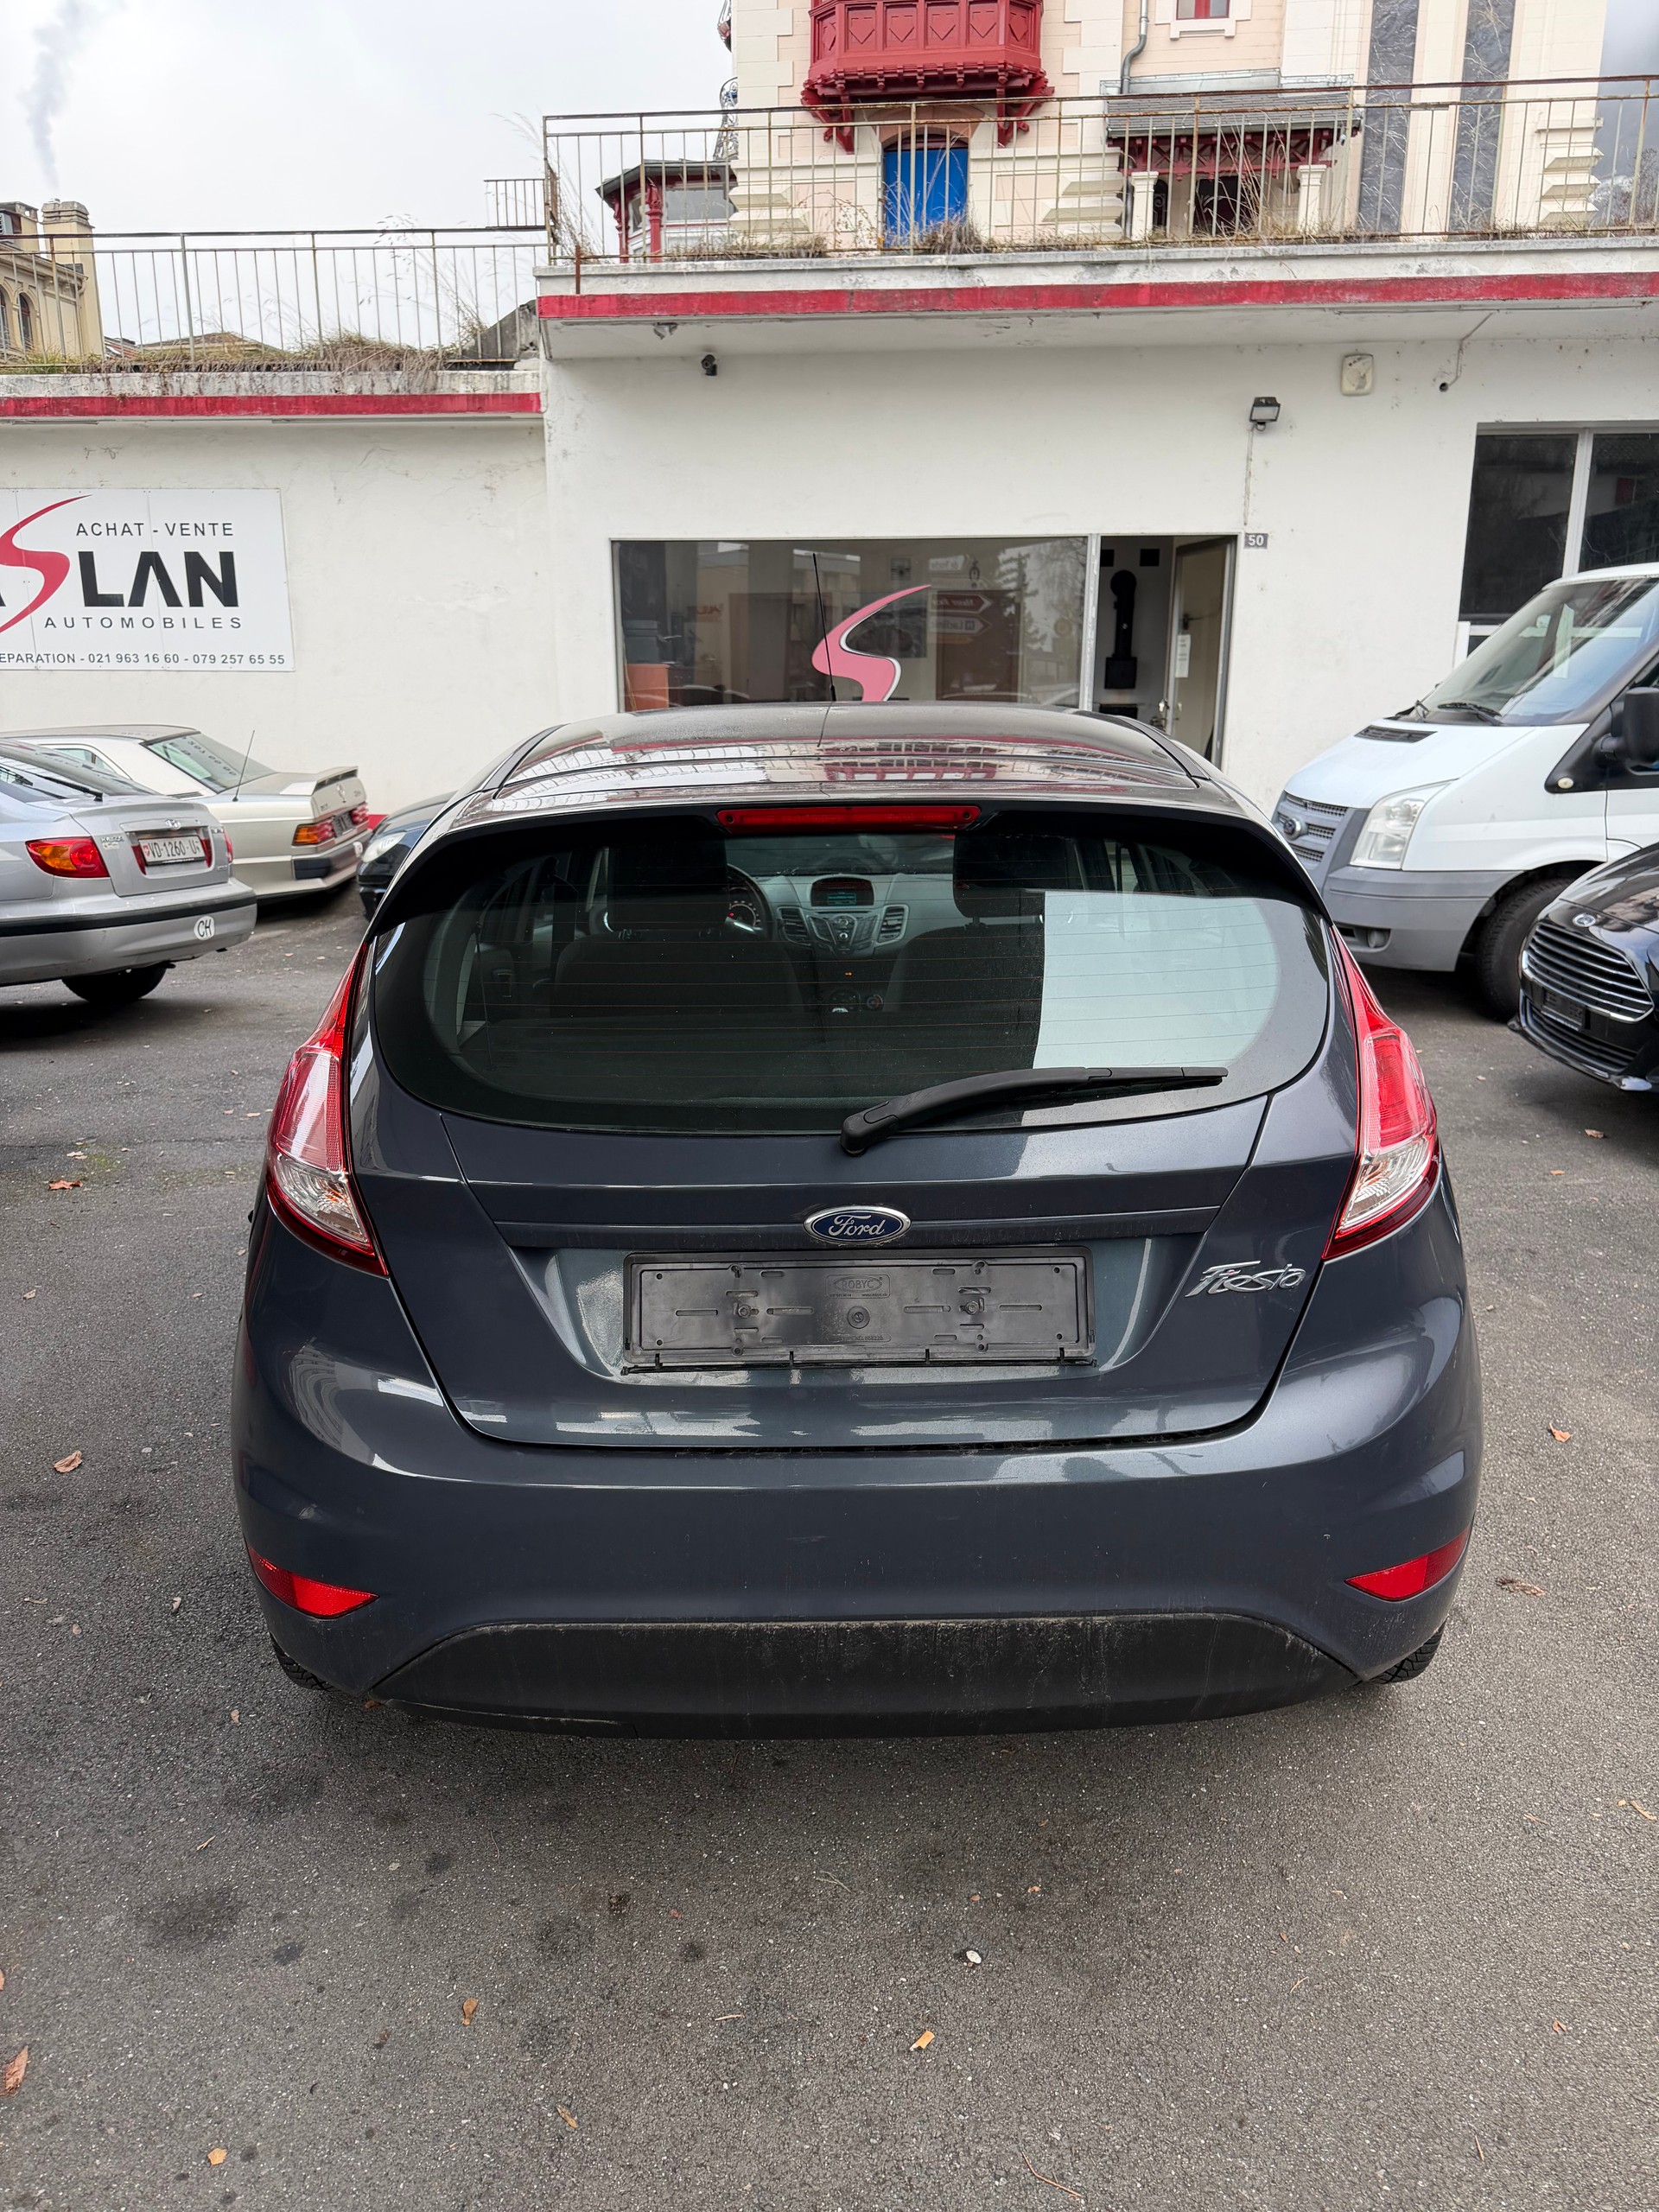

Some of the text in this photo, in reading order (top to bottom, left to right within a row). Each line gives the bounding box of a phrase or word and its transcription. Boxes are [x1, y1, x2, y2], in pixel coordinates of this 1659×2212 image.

[76, 523, 144, 537] ACHAT
[165, 523, 233, 537] VENTE
[1248, 535, 1264, 546] 50
[44, 617, 242, 629] AUTOMOBILES
[88, 653, 111, 663] 021
[116, 653, 139, 664] 963
[144, 653, 160, 664] 16
[164, 653, 180, 664] 60
[193, 654, 216, 664] 079
[221, 654, 244, 664] 257
[249, 654, 264, 664] 65
[269, 654, 285, 664] 55
[197, 918, 212, 938] CH
[828, 1214, 886, 1236] Ford
[1185, 1260, 1306, 1297] Fiesta
